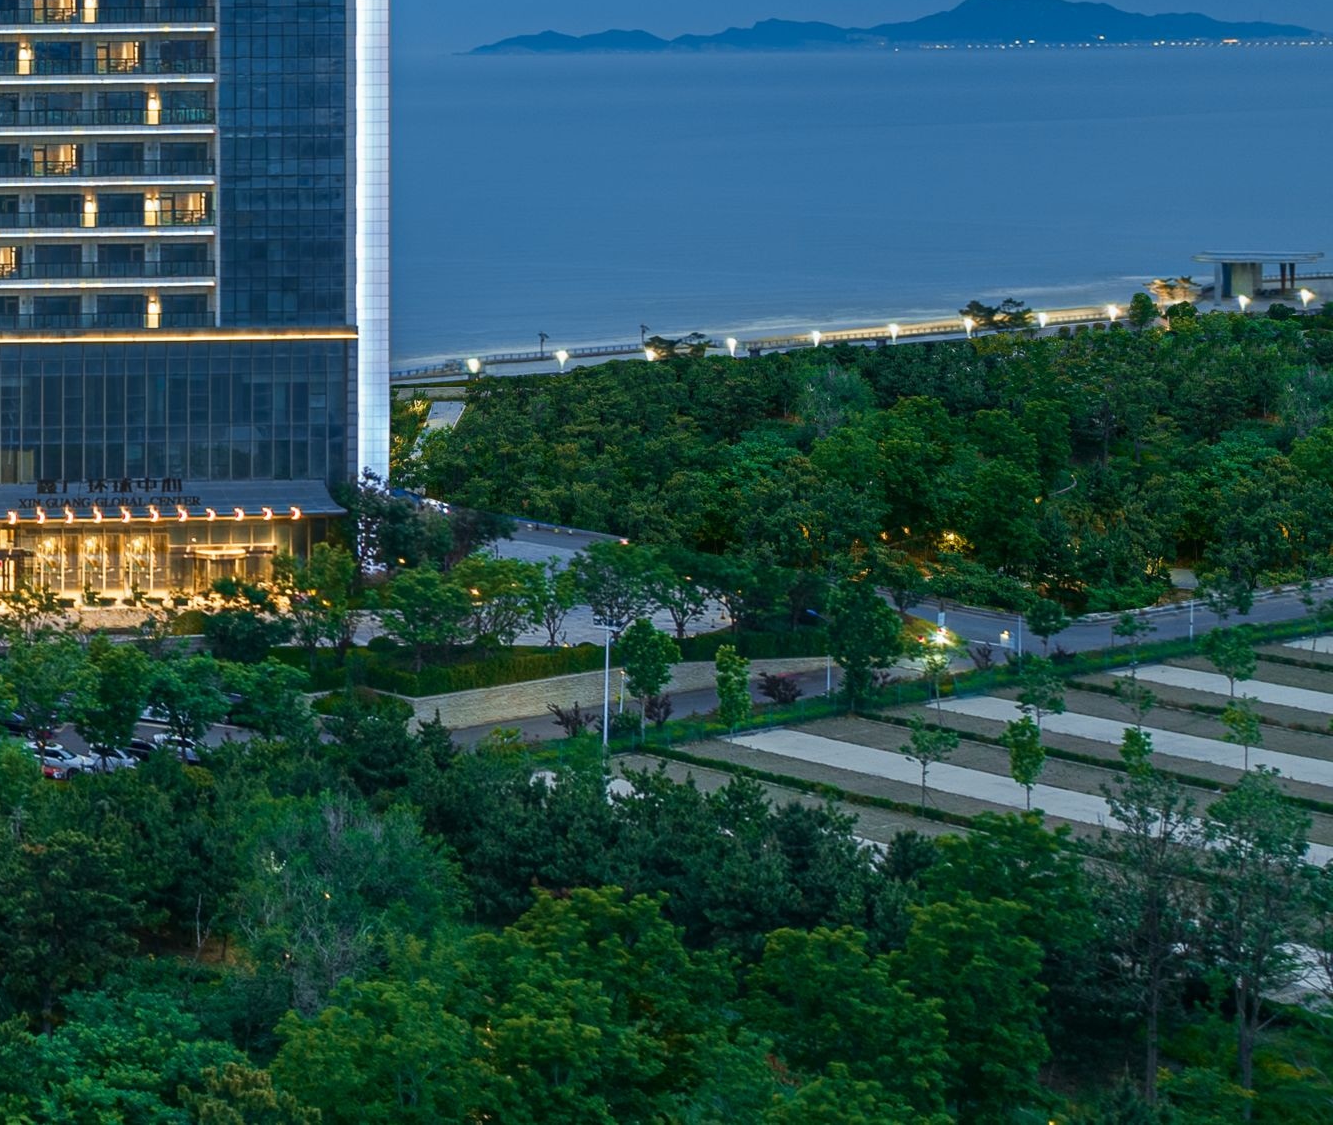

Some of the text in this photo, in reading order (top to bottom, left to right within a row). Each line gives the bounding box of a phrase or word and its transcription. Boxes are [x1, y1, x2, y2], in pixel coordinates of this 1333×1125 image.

[19, 495, 201, 509] XIN GUANG GLOBAL CENTER
